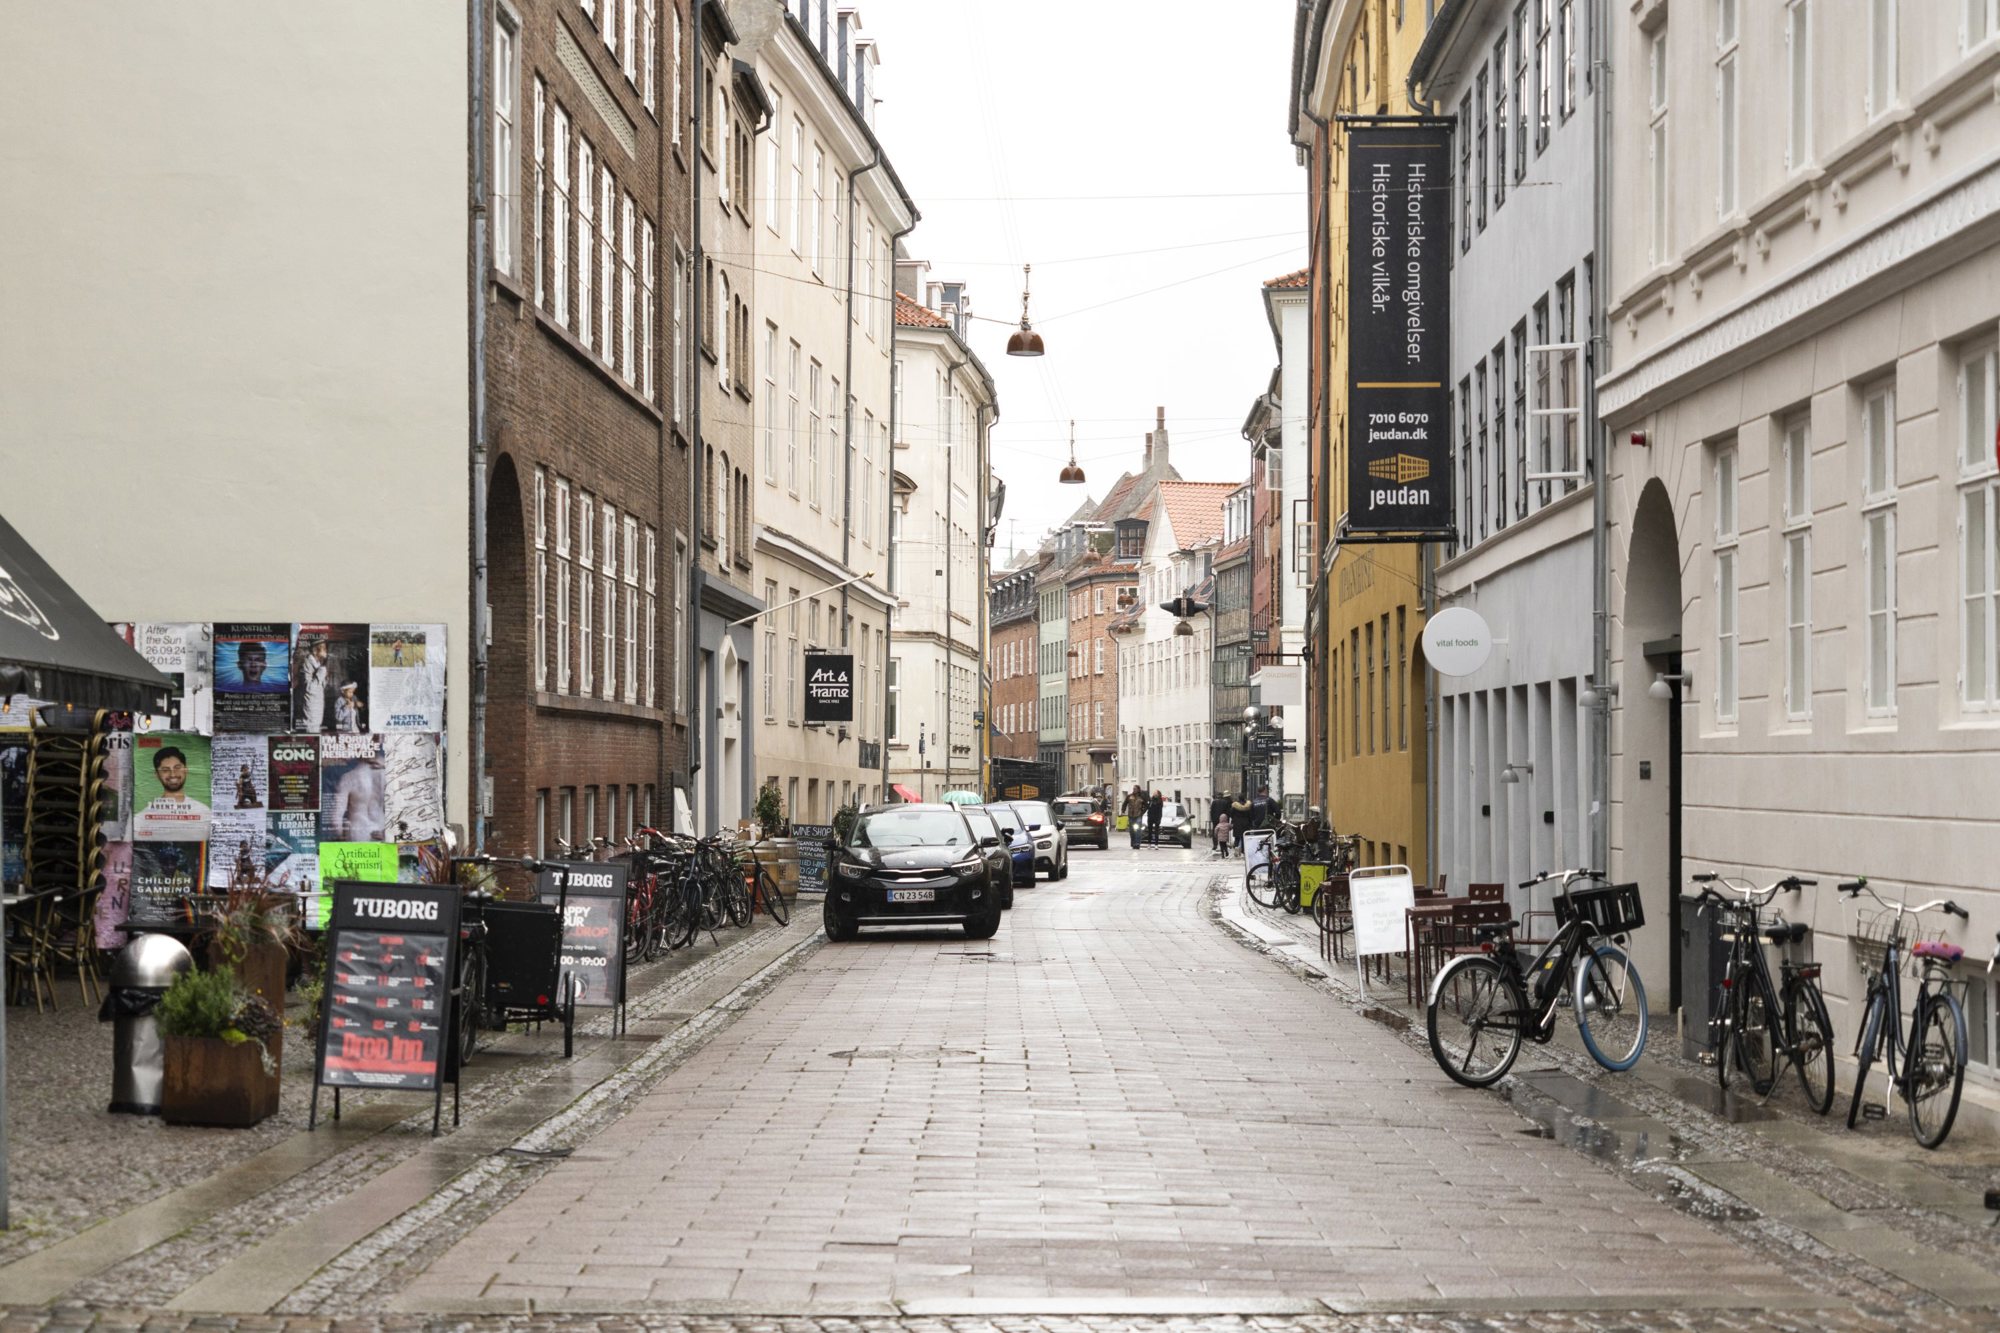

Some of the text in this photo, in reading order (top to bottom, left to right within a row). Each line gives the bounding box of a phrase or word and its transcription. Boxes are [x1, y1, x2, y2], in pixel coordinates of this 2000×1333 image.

[1372, 164, 1391, 315] Historiske vilkår.
[1402, 164, 1426, 365] Historiske omgivelser.
[1368, 412, 1429, 425] 7010 6070
[1368, 428, 1428, 443] jeudan.dk
[1369, 486, 1430, 511] jeudan
[146, 625, 168, 634] After
[146, 636, 182, 644] the Sun
[1455, 638, 1478, 646] foods
[146, 646, 186, 654] 26.09.24
[811, 668, 836, 682] Art
[810, 684, 849, 698] frame
[322, 743, 380, 752] THIS SPACE
[273, 749, 315, 760] GONG
[278, 821, 316, 829] TERRARIE
[792, 826, 832, 837] WINE SHOP
[337, 848, 380, 858] Artificial
[353, 898, 438, 920] TUBORG
[576, 927, 608, 936] DROP
[580, 957, 607, 966] 19:00
